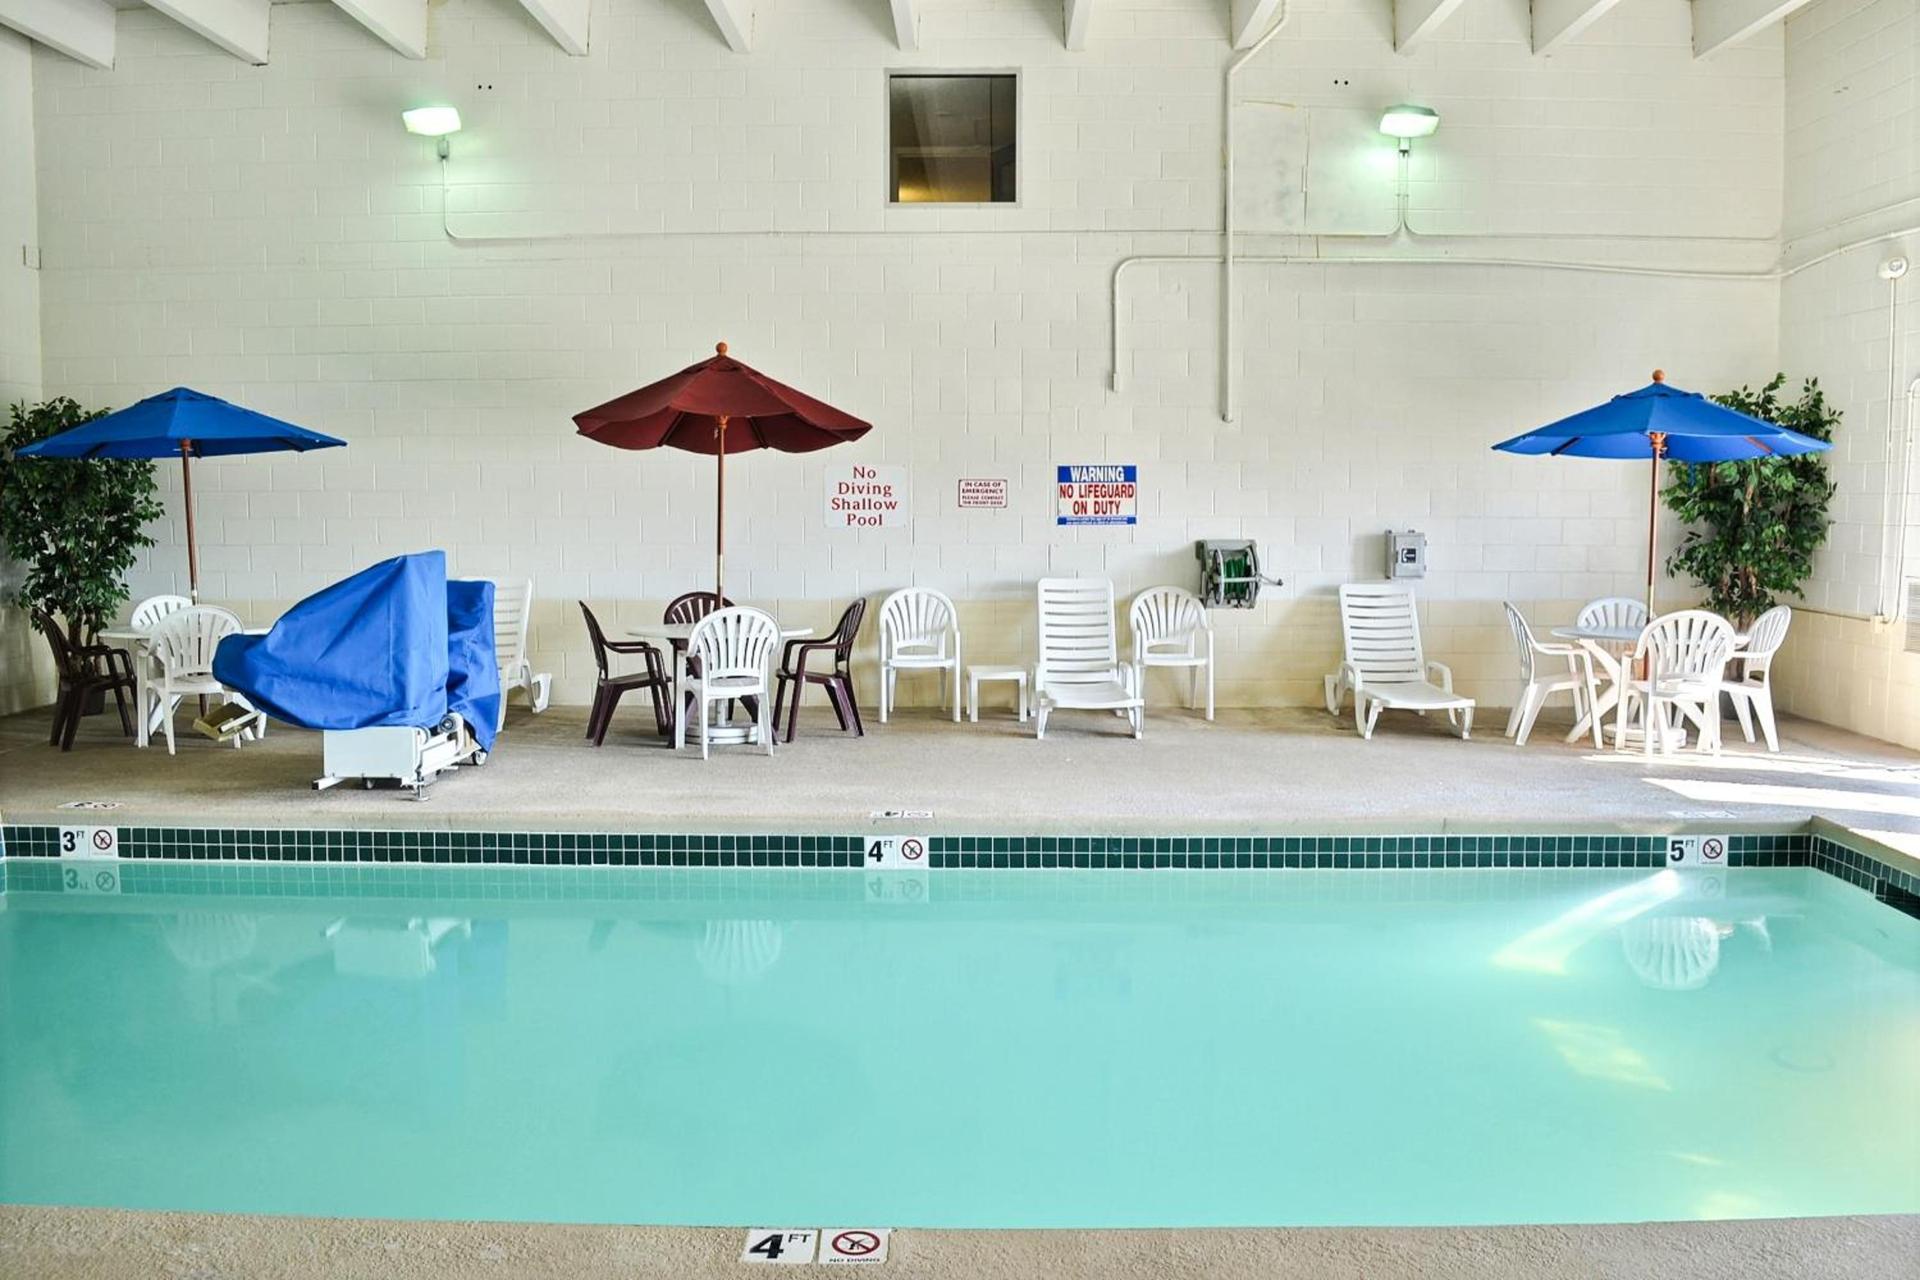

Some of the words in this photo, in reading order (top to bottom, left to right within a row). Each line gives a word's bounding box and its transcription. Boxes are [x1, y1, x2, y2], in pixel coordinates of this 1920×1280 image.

[853, 466, 876, 479] No
[1070, 466, 1125, 482] WARNING
[838, 482, 892, 497] Diving
[1059, 484, 1074, 499] NO
[1079, 484, 1135, 499] LIFEGUARD
[831, 497, 898, 510] Shallow
[1073, 500, 1087, 515] ON
[1094, 500, 1121, 515] DUTY
[847, 513, 882, 526] Pool
[62, 830, 76, 852] 3
[76, 830, 85, 839] FT
[868, 840, 883, 862] 4
[883, 840, 893, 848] FT
[1670, 840, 1684, 862] 5
[1685, 840, 1695, 848] FT
[749, 1234, 784, 1259] 4
[788, 1233, 811, 1243] FT
